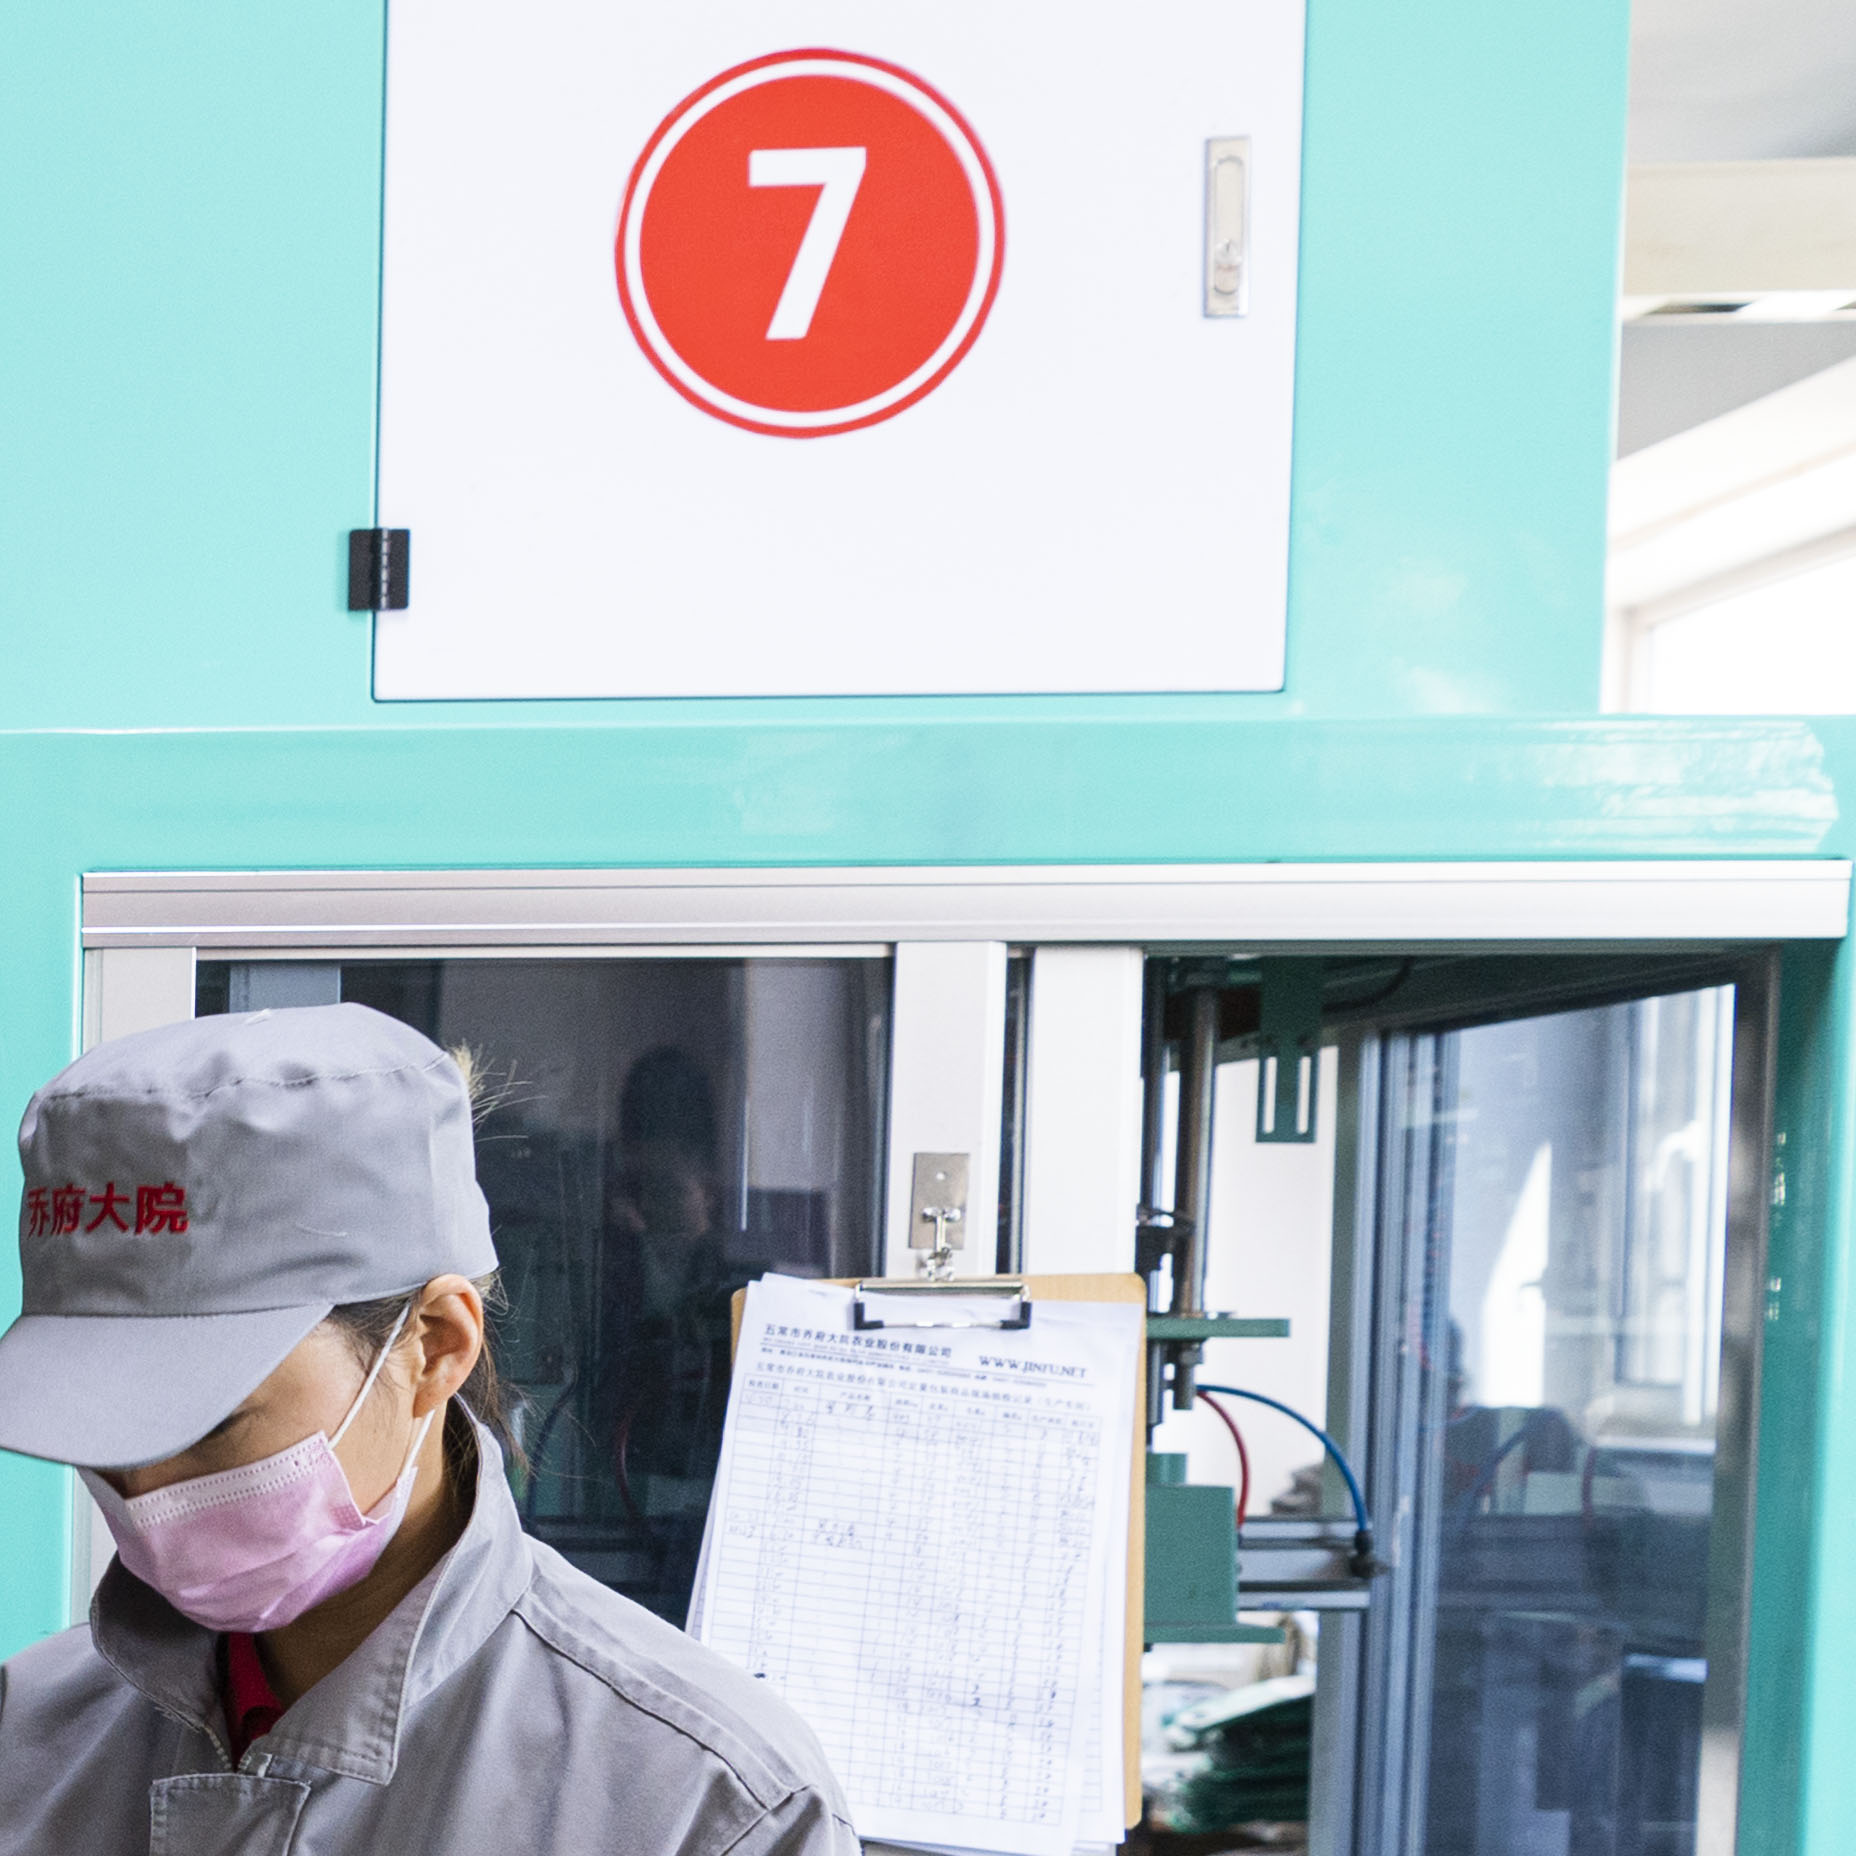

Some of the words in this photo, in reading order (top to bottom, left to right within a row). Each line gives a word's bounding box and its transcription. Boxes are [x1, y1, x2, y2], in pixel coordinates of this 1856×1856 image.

[748, 146, 867, 340] 7
[27, 1181, 189, 1237] 乔府大院
